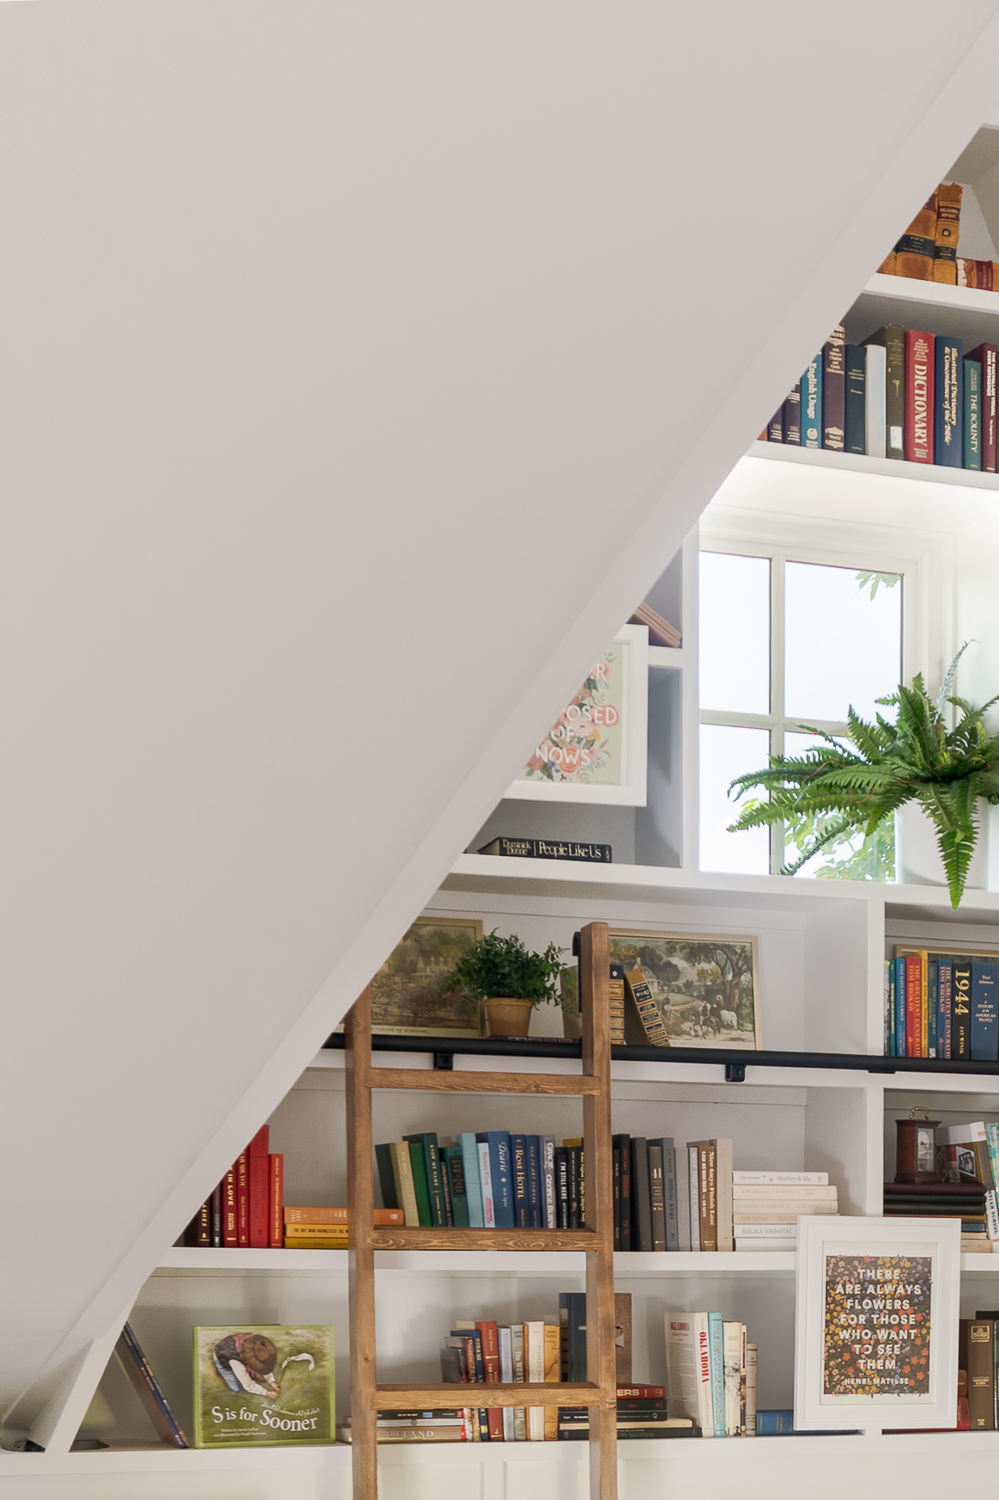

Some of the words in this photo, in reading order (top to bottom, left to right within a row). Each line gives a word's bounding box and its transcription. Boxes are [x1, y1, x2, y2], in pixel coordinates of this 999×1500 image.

[808, 362, 818, 393] English
[807, 394, 817, 419] Usage
[914, 364, 927, 450] DICTIONARY
[535, 747, 591, 766] NOWS
[502, 839, 532, 849] Dominick
[507, 846, 528, 856] Dunne
[539, 842, 567, 858] People
[569, 844, 588, 857] Like
[589, 846, 601, 858] Us
[955, 970, 970, 1015] 1944
[515, 1150, 523, 1170] ROSE
[777, 1175, 796, 1183] Marley
[517, 1172, 525, 1199] HOTEL
[857, 1269, 900, 1279] THERE
[835, 1284, 861, 1294] ARE
[867, 1284, 921, 1295] ALWAYS
[847, 1299, 910, 1310] FLOWERS
[840, 1315, 867, 1325] FOR
[872, 1314, 916, 1324] THOSE
[839, 1330, 872, 1340] WHO
[877, 1330, 917, 1340] WANT
[854, 1345, 873, 1355] TO
[878, 1345, 901, 1355] SEE
[699, 1331, 710, 1383] OKLAHOMA
[858, 1360, 896, 1370] THEM
[844, 1377, 870, 1385] HENRI
[211, 1406, 224, 1424] S
[226, 1408, 237, 1420] is
[239, 1407, 258, 1422] for
[260, 1409, 318, 1432] Sooner
[403, 1430, 435, 1439] LAND
